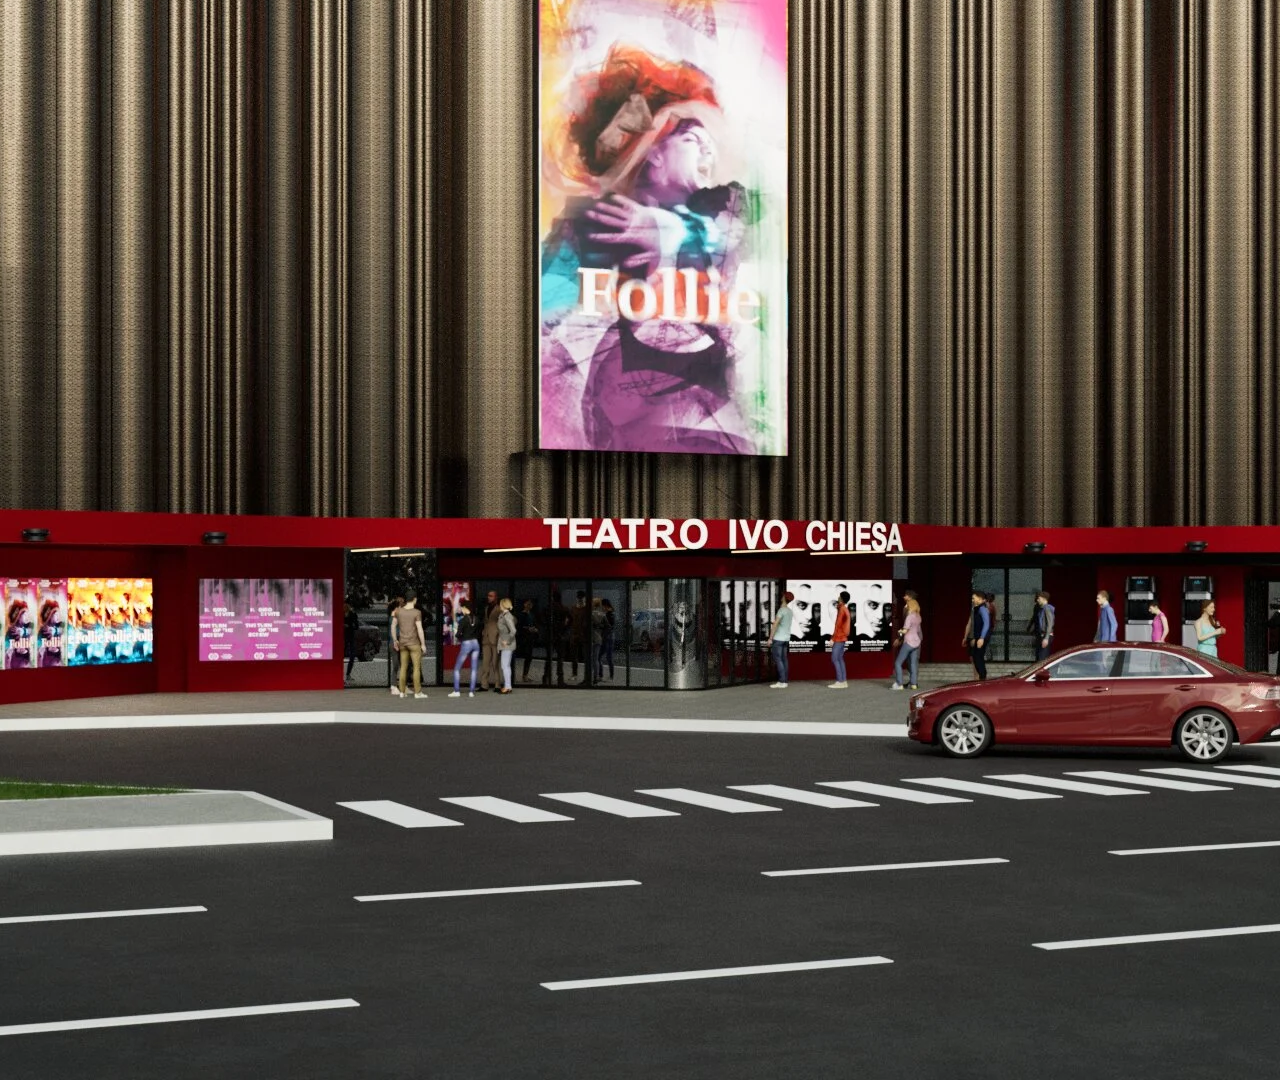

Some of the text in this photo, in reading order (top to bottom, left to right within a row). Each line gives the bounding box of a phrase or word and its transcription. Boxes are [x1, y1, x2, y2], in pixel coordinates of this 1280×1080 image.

[577, 266, 761, 324] Follie
[542, 517, 904, 552] TEATRO IVO CHIESA
